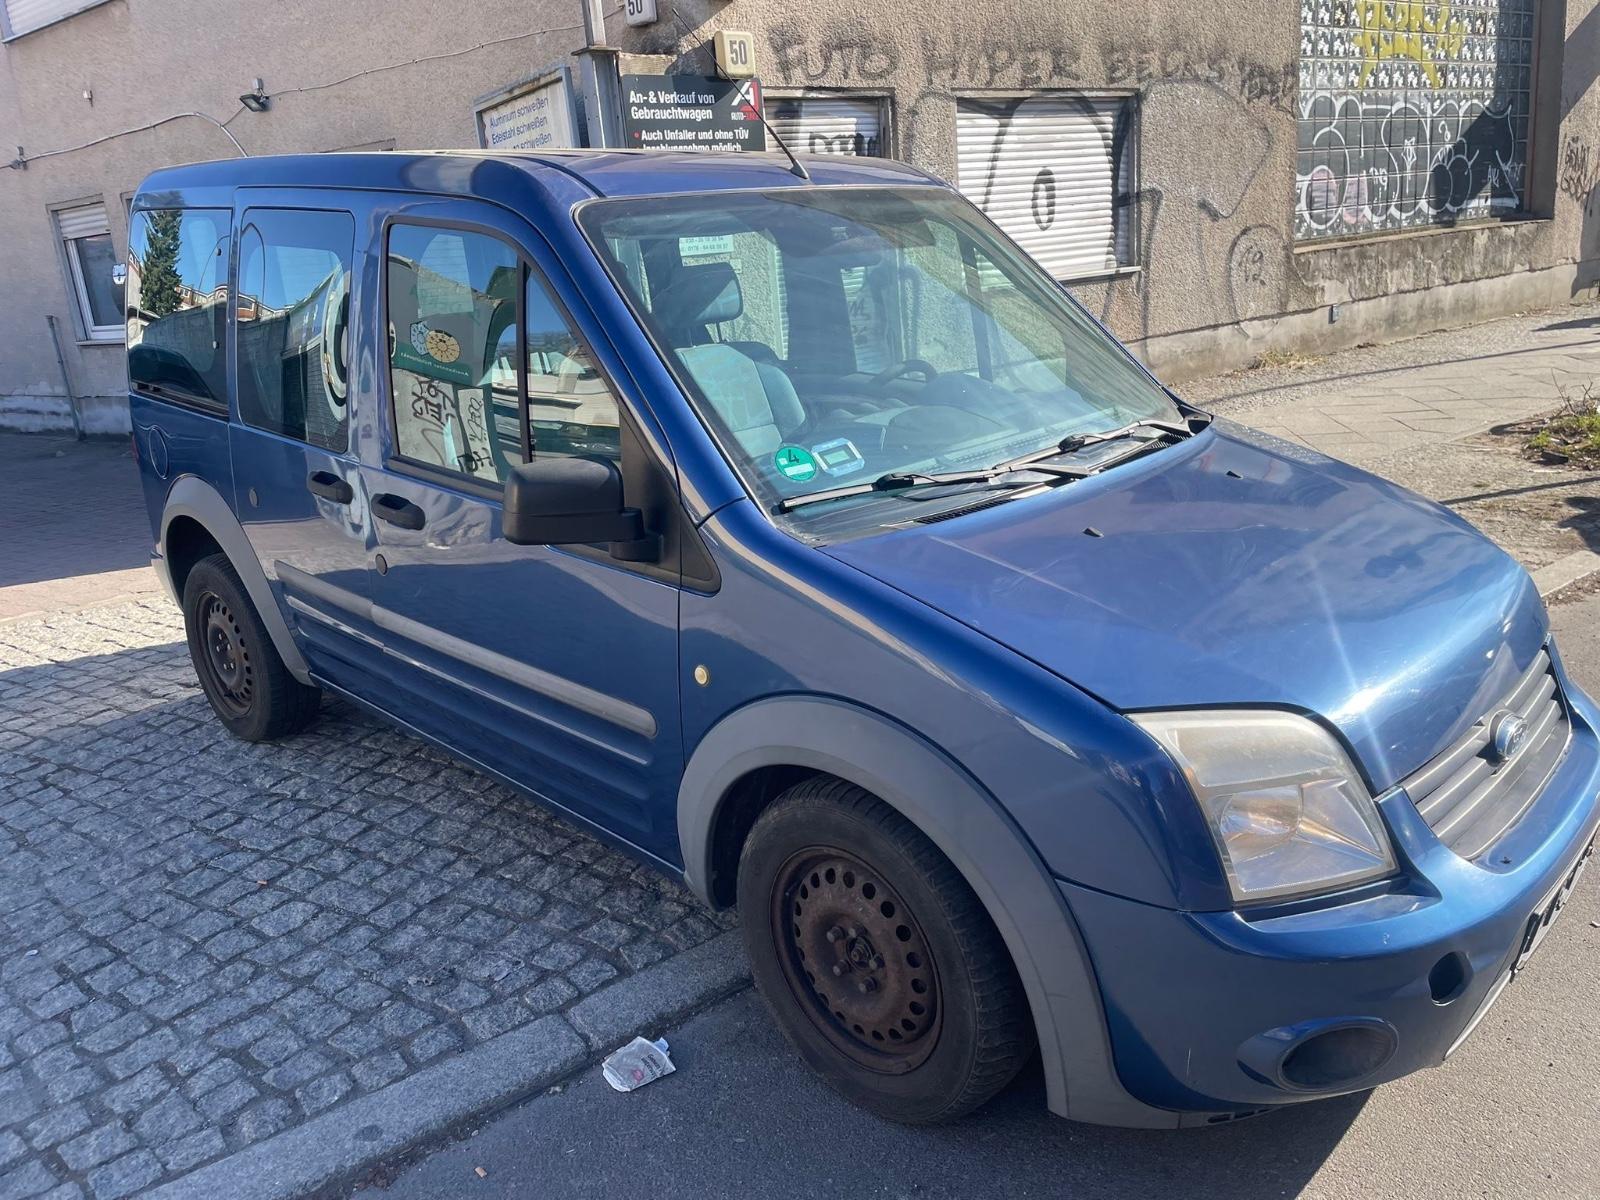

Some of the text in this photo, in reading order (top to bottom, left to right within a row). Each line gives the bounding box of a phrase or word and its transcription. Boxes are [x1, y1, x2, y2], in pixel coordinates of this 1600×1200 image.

[729, 40, 747, 65] 50
[629, 90, 715, 104] An- & Verkauf von
[490, 96, 549, 129] Aluminium schweißen
[631, 106, 713, 122] Gebrauchtwagen
[492, 115, 548, 145] Edelstahl schweißen
[641, 129, 664, 141] Auch
[698, 129, 713, 140] und
[715, 129, 734, 140] ohne
[734, 127, 750, 140] TÜV
